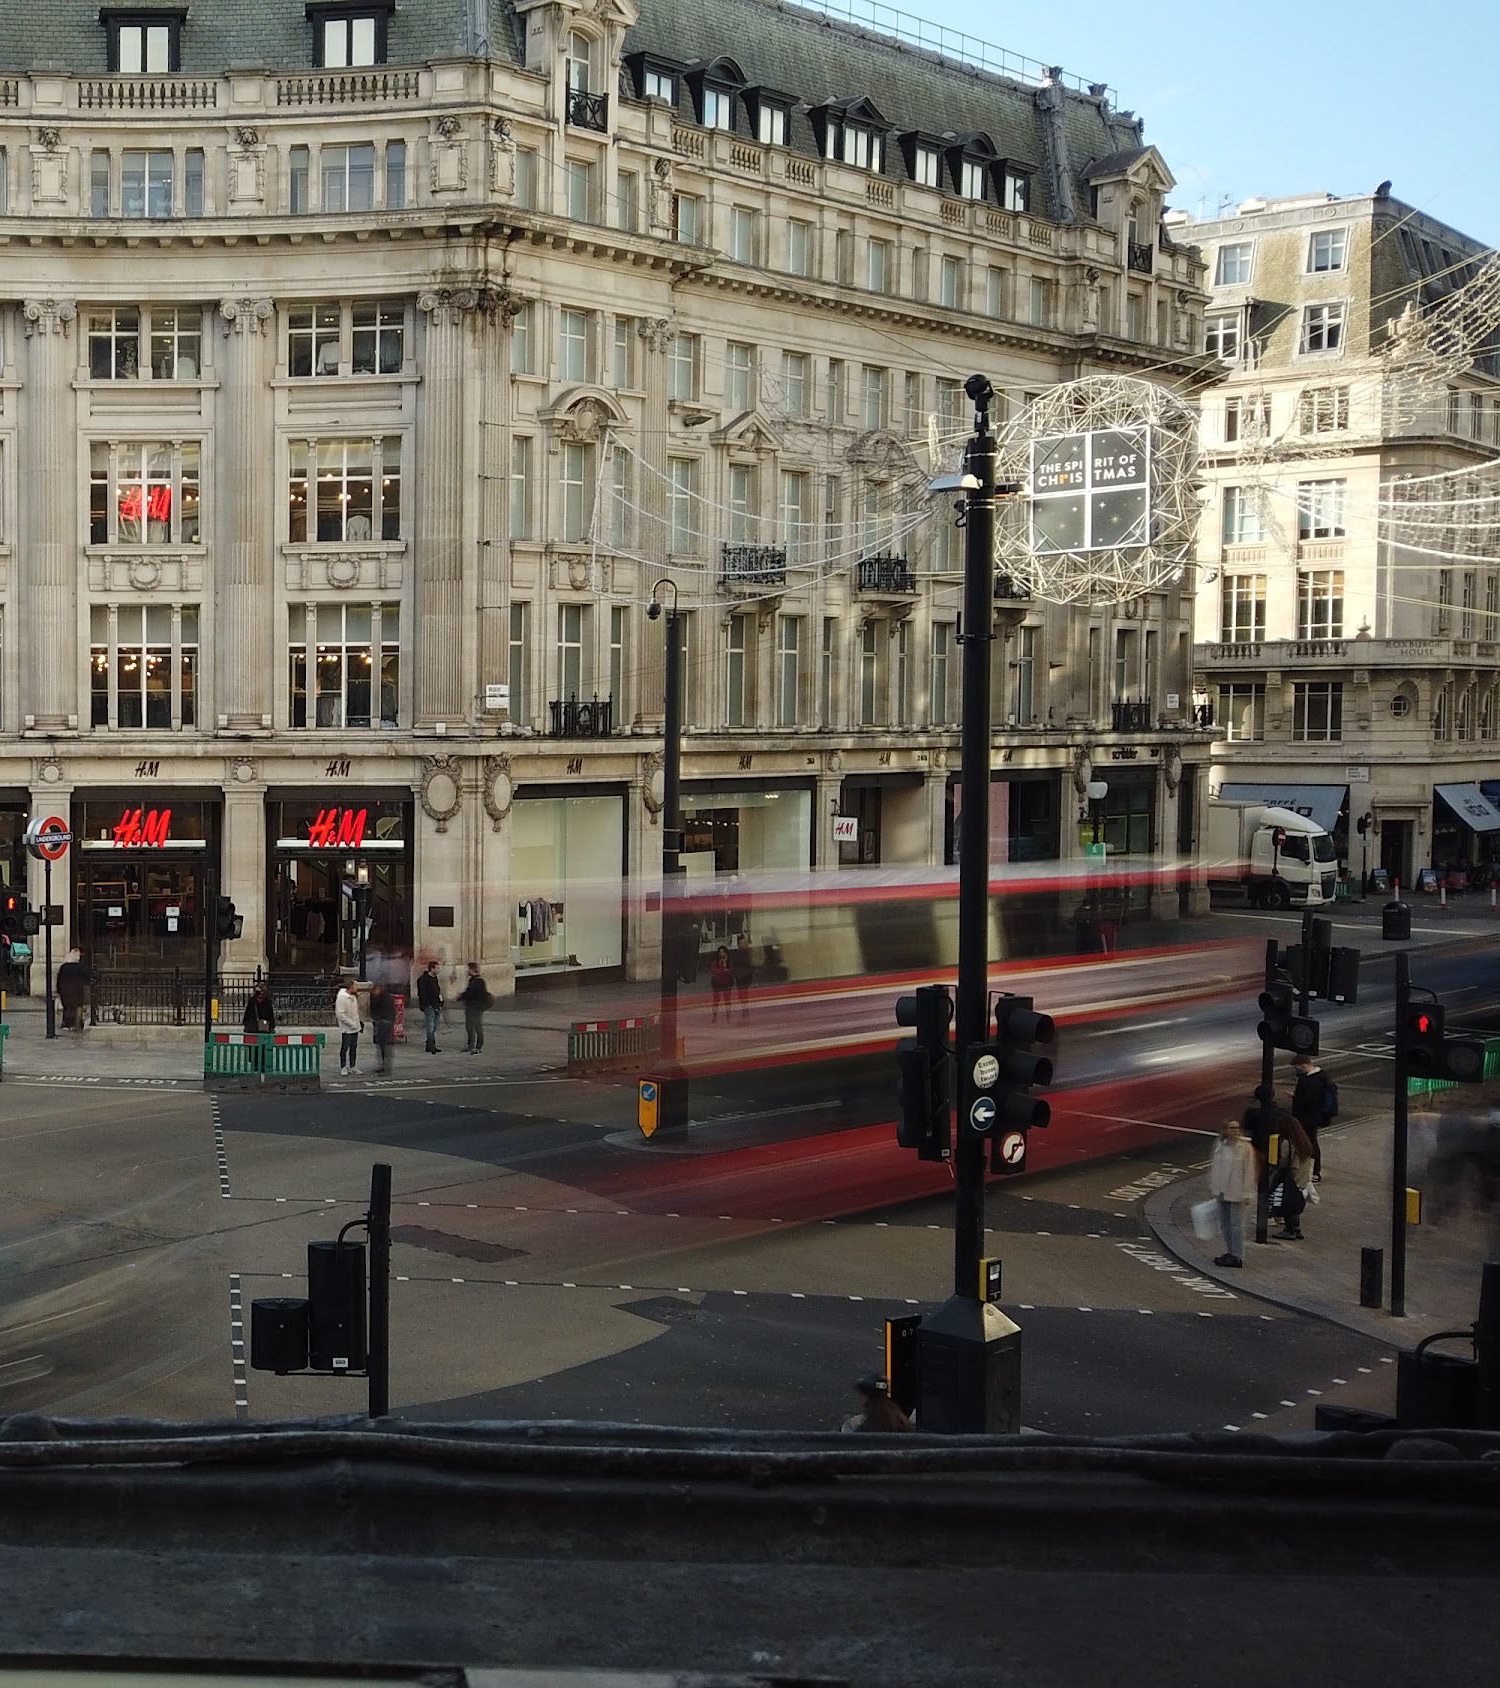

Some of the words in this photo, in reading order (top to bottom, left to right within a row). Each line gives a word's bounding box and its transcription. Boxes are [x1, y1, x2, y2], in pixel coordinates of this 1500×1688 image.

[1040, 463, 1062, 474] THE
[1119, 454, 1137, 465] OF
[134, 761, 160, 777] H&M
[325, 760, 351, 777] H&M
[567, 758, 582, 774] H&M
[738, 755, 753, 770] H&M
[113, 809, 171, 848] H&M
[308, 808, 367, 848] H&M
[834, 822, 854, 836] H&M
[35, 833, 72, 844] UNDERGROUND
[978, 1058, 996, 1069] Except
[980, 1067, 997, 1076] buses
[1103, 1185, 1154, 1201] LOOK
[1122, 1248, 1189, 1272] RIGHT
[1171, 1275, 1238, 1299] LOOK
